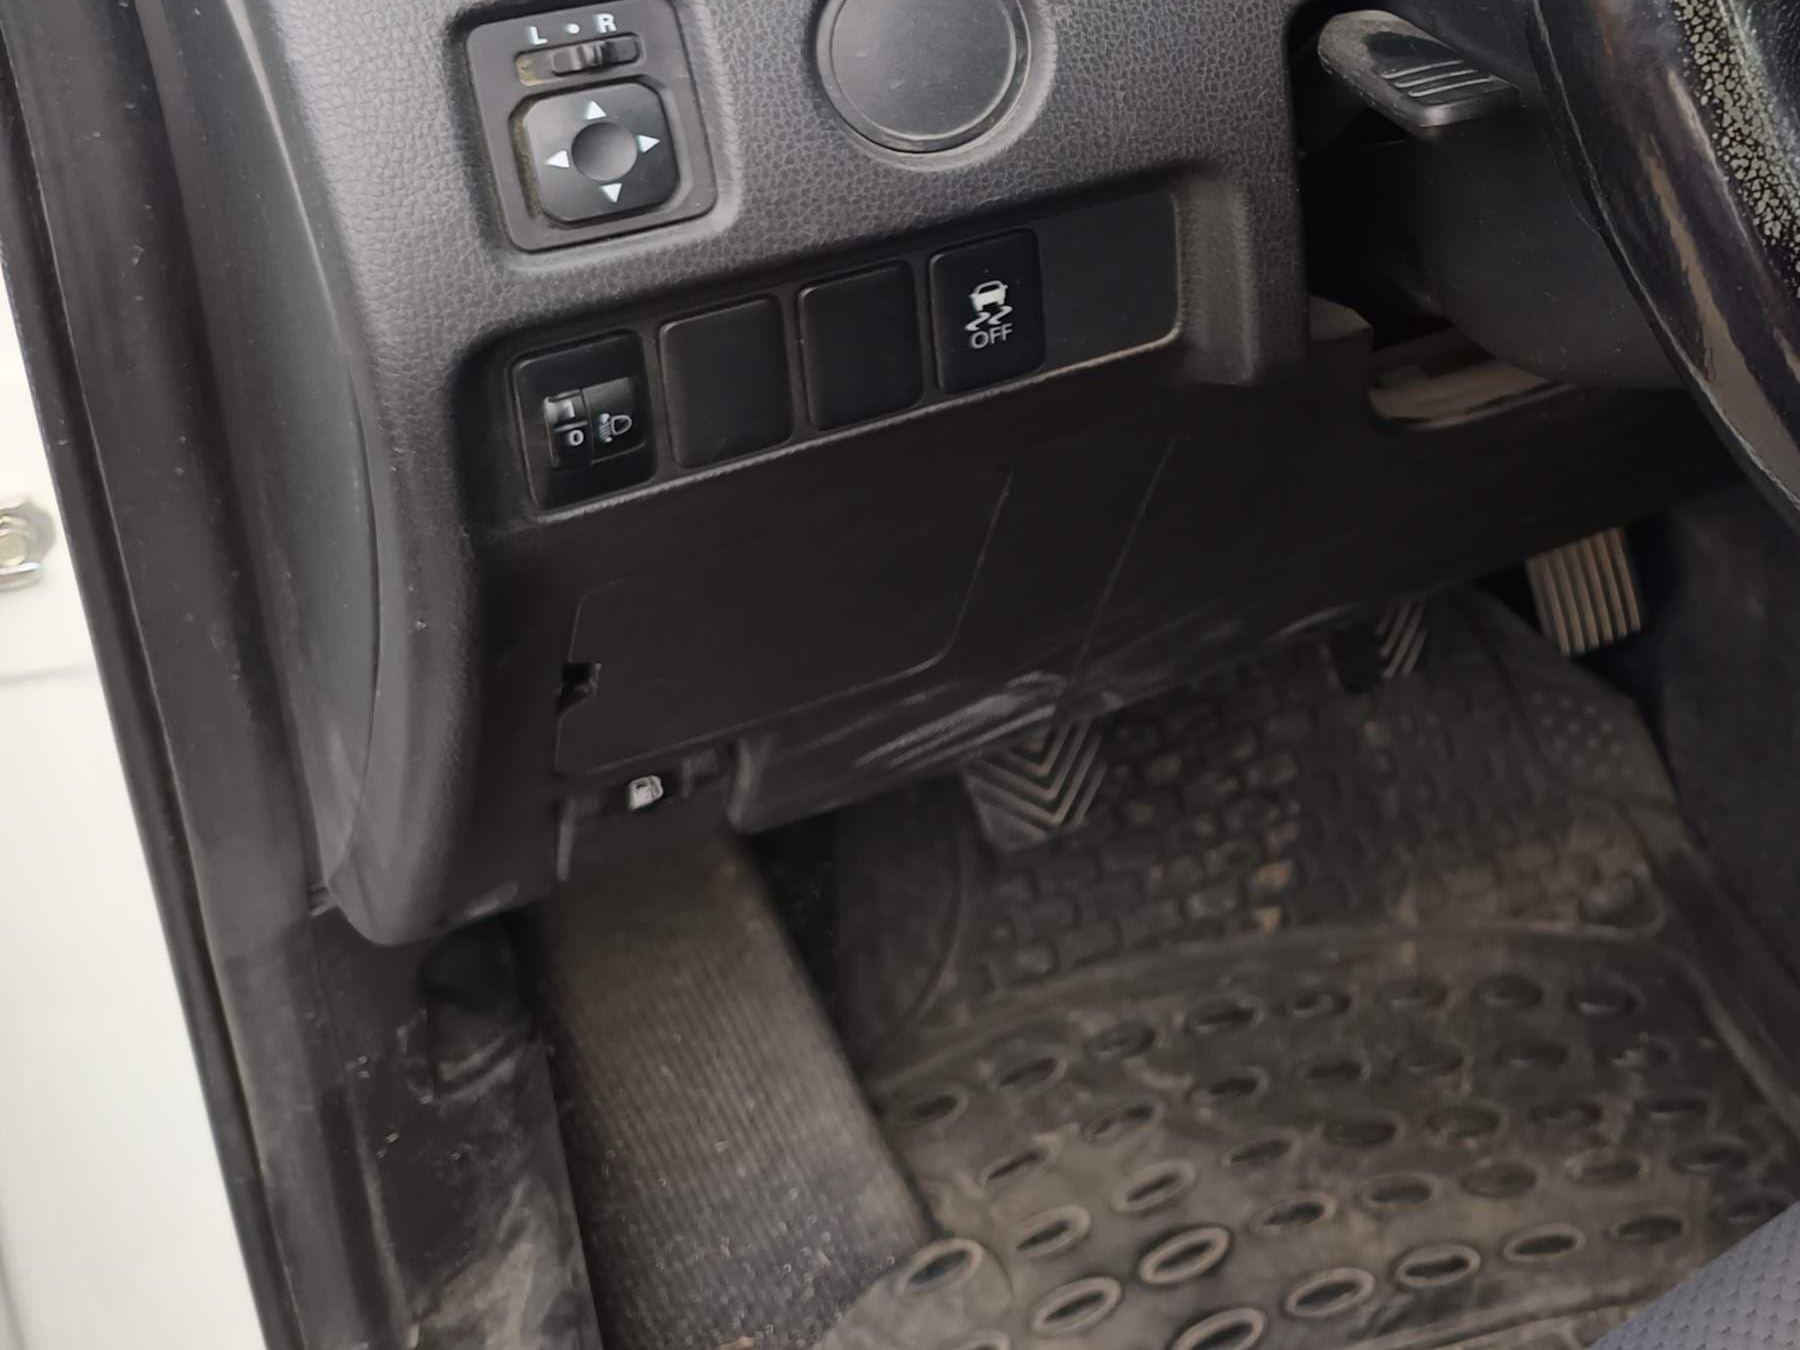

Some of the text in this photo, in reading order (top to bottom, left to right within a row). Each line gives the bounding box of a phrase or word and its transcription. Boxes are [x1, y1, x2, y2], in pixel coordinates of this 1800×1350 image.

[526, 13, 617, 45] L R
[970, 322, 1014, 349] OFF
[568, 429, 585, 447] 0
